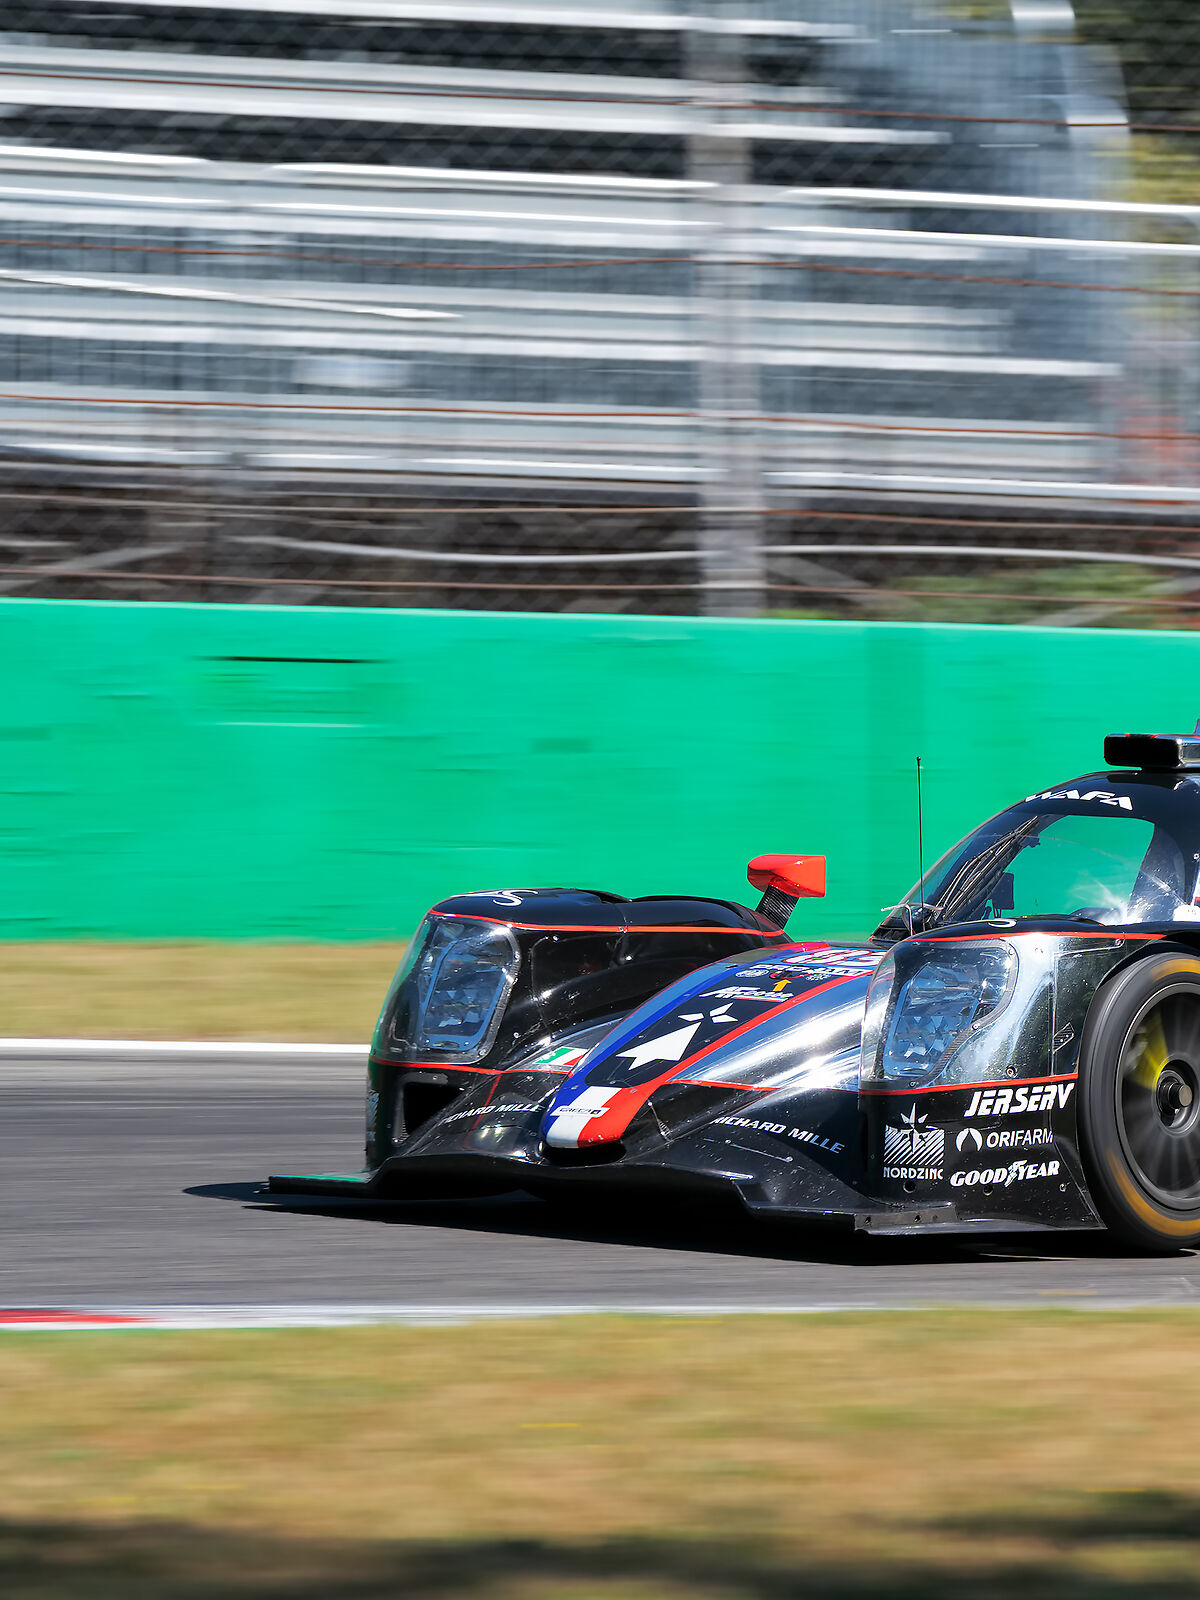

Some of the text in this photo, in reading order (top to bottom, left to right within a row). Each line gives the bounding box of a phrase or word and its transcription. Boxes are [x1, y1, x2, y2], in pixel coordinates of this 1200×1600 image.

[963, 1083, 1075, 1117] JERSERV
[788, 1128, 845, 1154] MILLE
[986, 1129, 1053, 1148] ORIFARM
[883, 1166, 944, 1180] NORDZINC
[950, 1159, 1061, 1188] GOODYEAR
